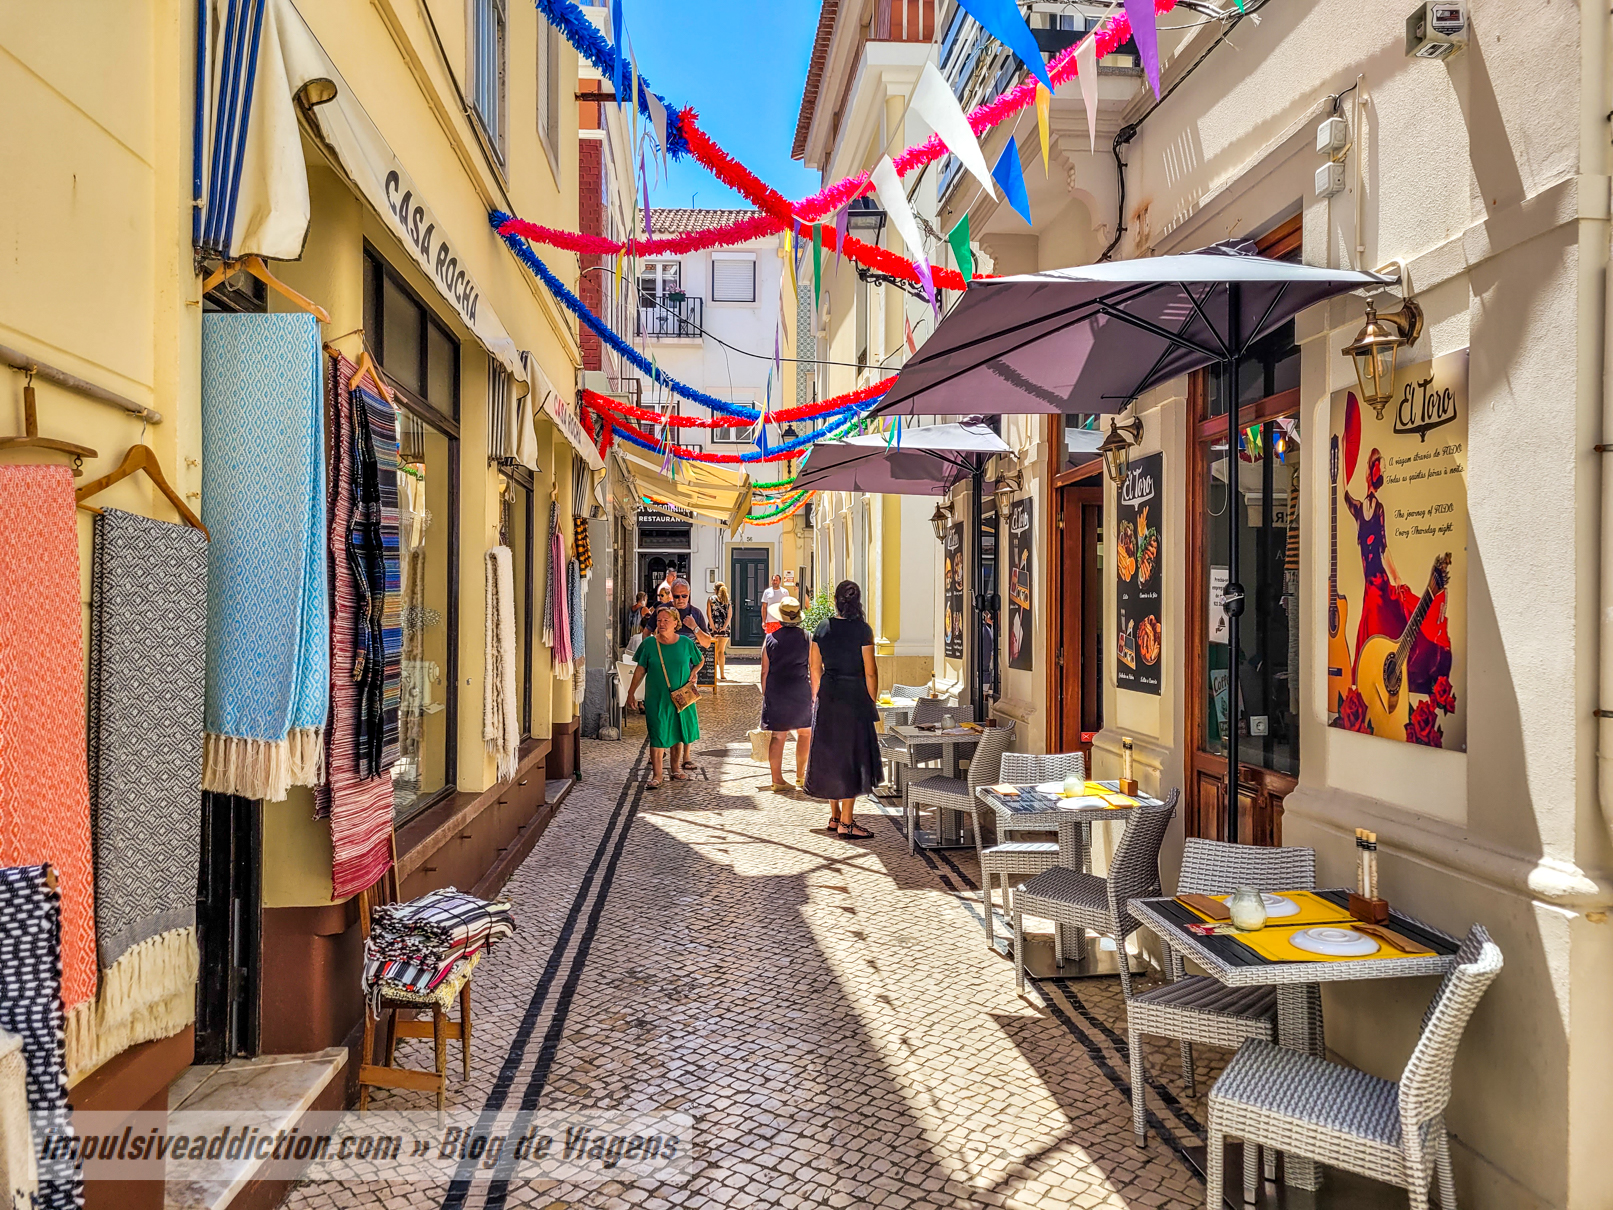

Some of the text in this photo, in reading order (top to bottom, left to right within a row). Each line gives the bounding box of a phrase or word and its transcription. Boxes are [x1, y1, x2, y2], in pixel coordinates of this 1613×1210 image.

[385, 170, 479, 326] CASA ROCHA
[1398, 373, 1454, 427] El Toro
[1413, 451, 1432, 461] através
[1433, 448, 1441, 457] do
[1123, 466, 1152, 500] El Toro
[1386, 474, 1401, 484] Todas
[1408, 470, 1426, 484] quintas
[1427, 468, 1442, 479] feiras
[1394, 509, 1405, 519] The
[1405, 510, 1426, 521] journey
[1427, 505, 1434, 517] of
[1395, 528, 1410, 539] Every
[1411, 525, 1436, 536] Thursday
